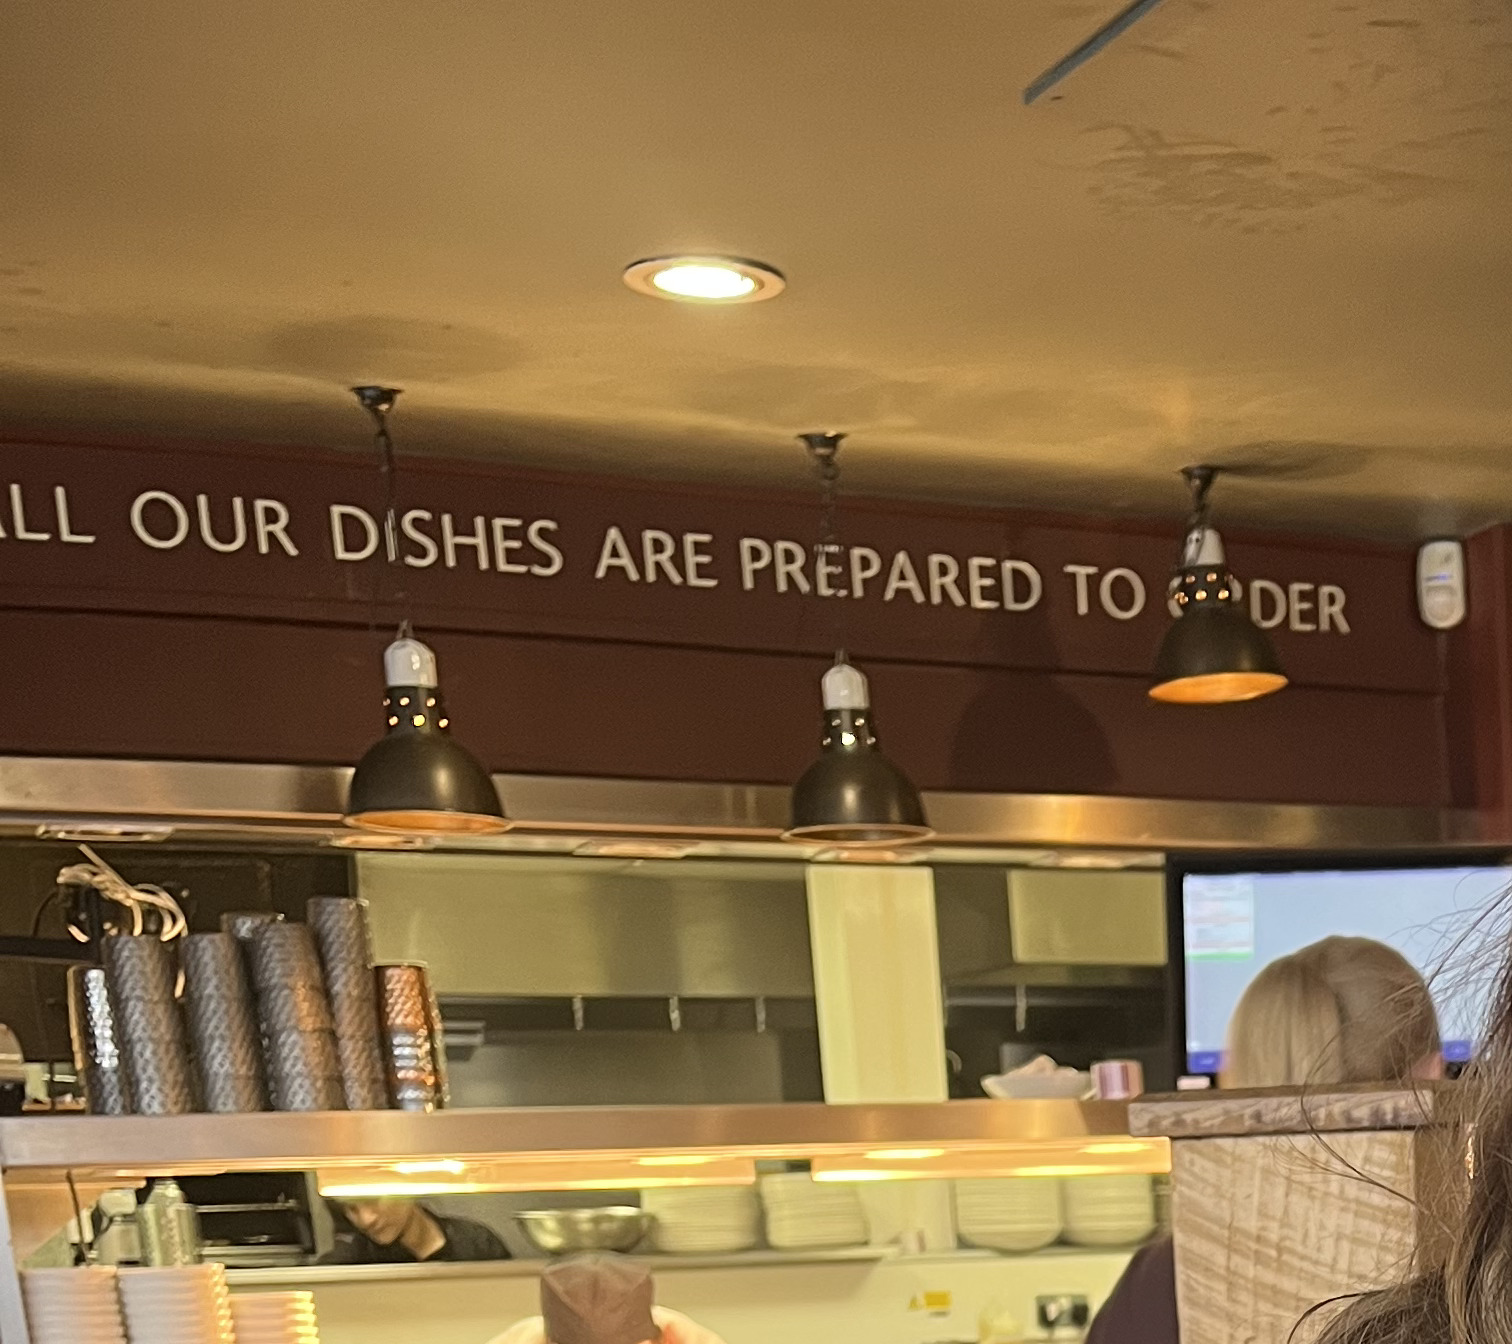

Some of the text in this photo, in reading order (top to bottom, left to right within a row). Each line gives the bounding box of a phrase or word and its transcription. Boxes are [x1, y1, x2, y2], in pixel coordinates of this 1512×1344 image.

[0, 482, 1351, 635] LL OUR DISHES ARE PREPARED TO DER
